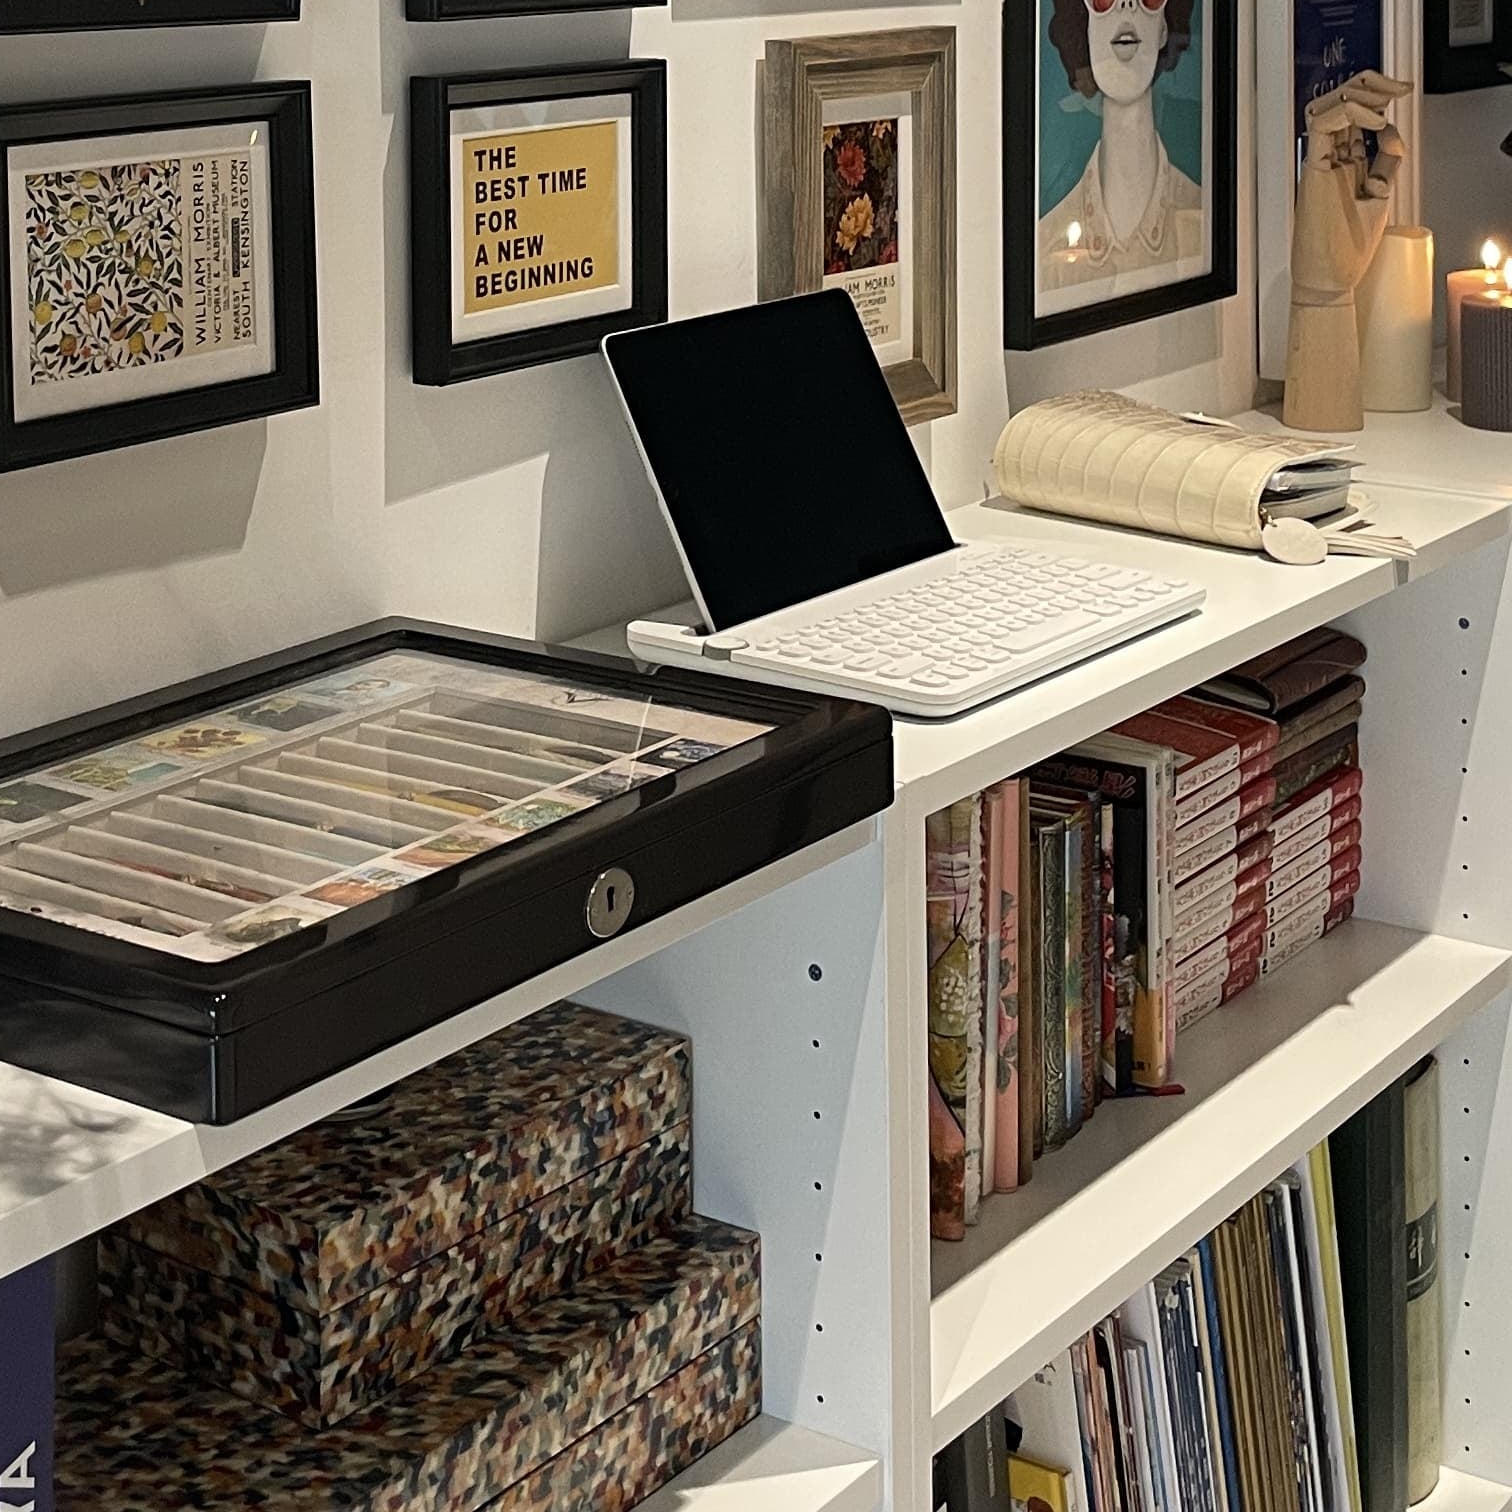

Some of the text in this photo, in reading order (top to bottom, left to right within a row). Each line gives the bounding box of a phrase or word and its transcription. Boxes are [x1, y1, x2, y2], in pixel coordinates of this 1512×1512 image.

[473, 145, 517, 172] THE
[211, 160, 219, 214] MUSEUM
[231, 159, 239, 207] STATION
[474, 167, 588, 204] BEST TIME
[212, 218, 221, 263] ALBERT
[474, 208, 518, 236] FOR
[193, 162, 206, 345] WILLIAM MORRIS
[241, 161, 251, 338] SOUTH KENSINGTON
[474, 234, 545, 268] A NEW
[474, 256, 594, 299] BEGINNING
[214, 285, 222, 343] VICTORIA
[232, 289, 241, 341] NEAREST
